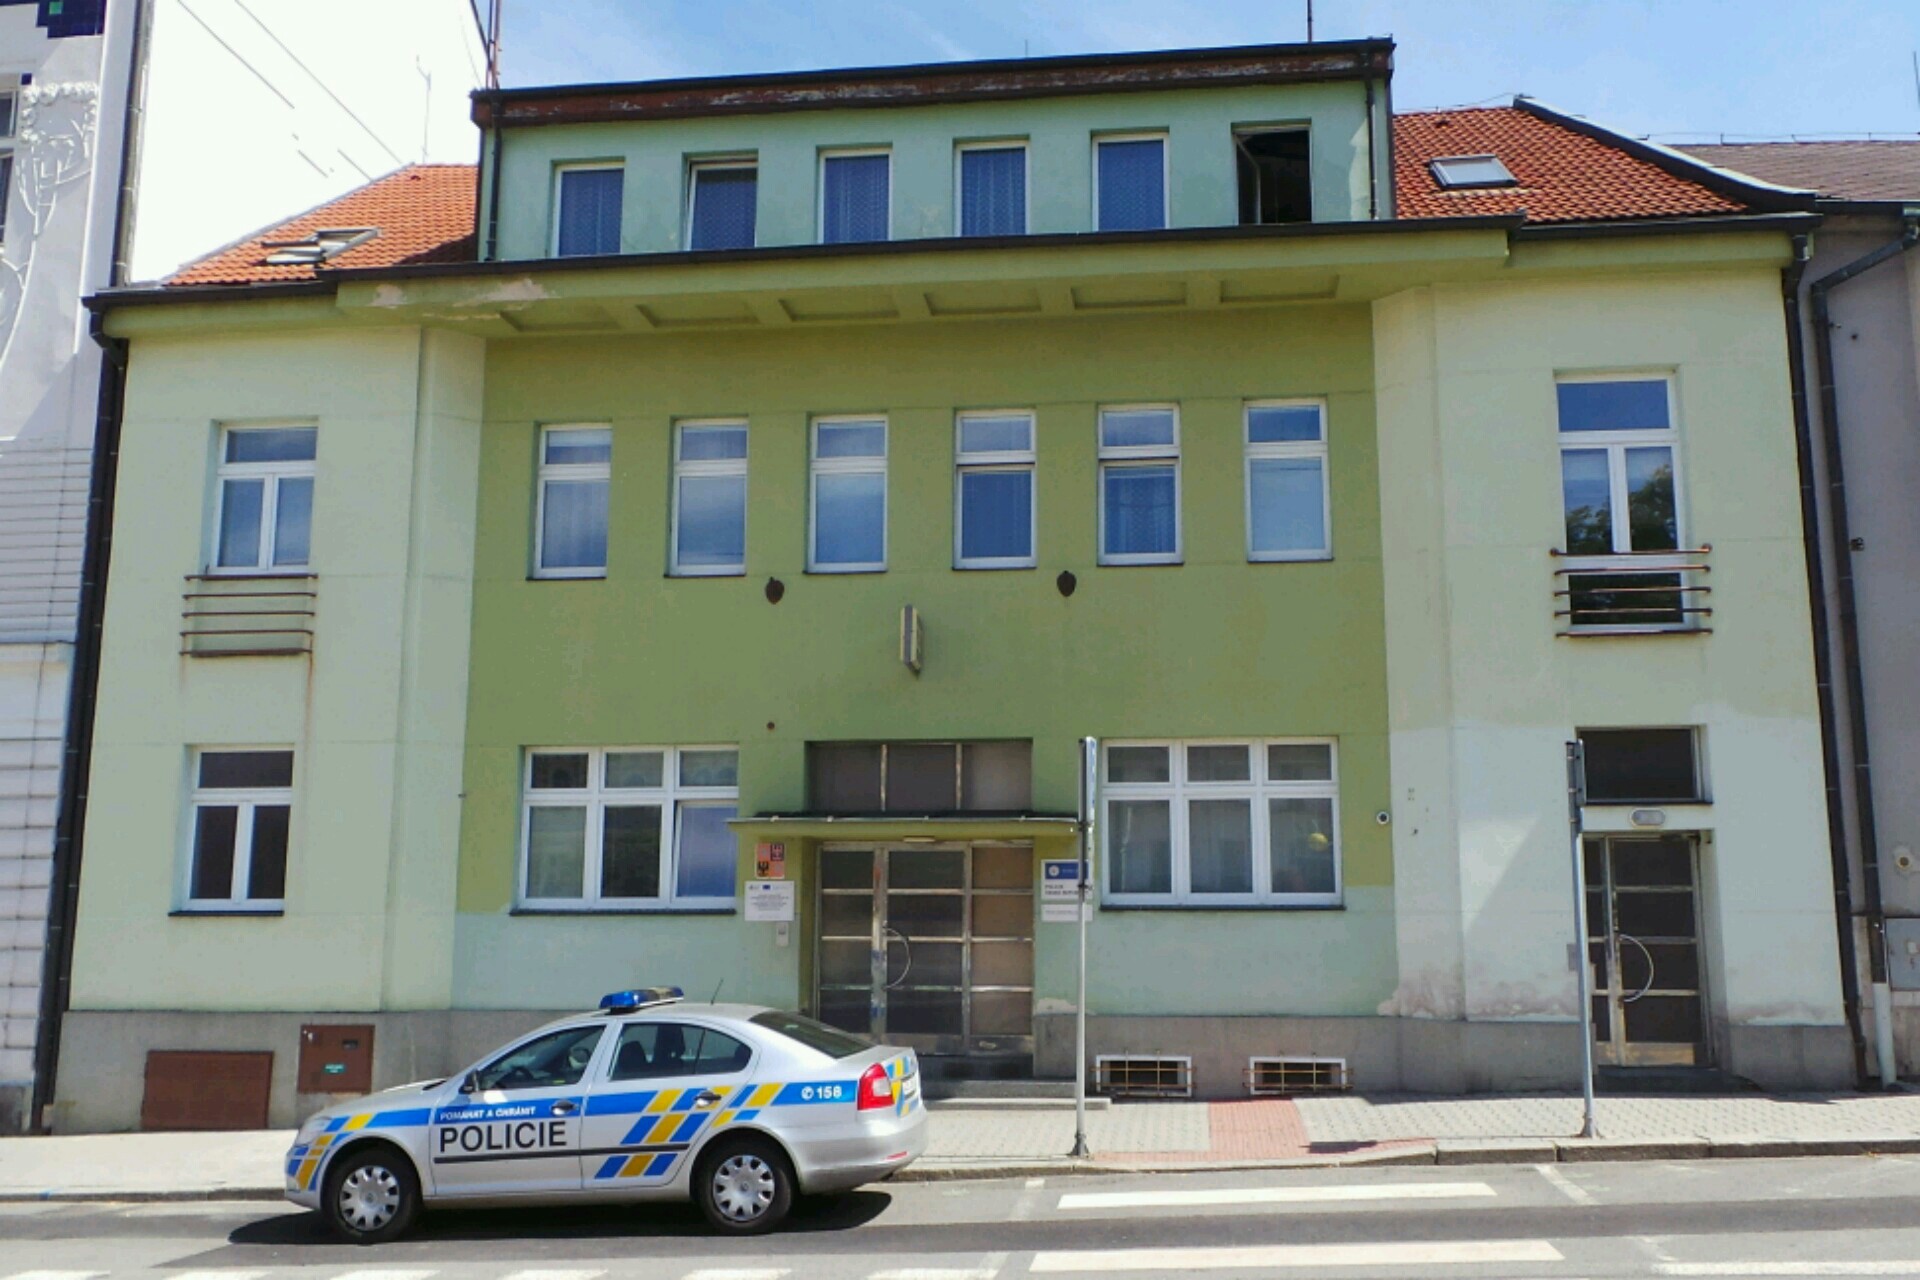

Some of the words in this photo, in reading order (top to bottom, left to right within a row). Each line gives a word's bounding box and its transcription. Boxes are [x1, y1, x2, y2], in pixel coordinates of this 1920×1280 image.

[816, 1085, 842, 1100] 158
[486, 1109, 494, 1118] A
[440, 1121, 567, 1153] POLICIE
